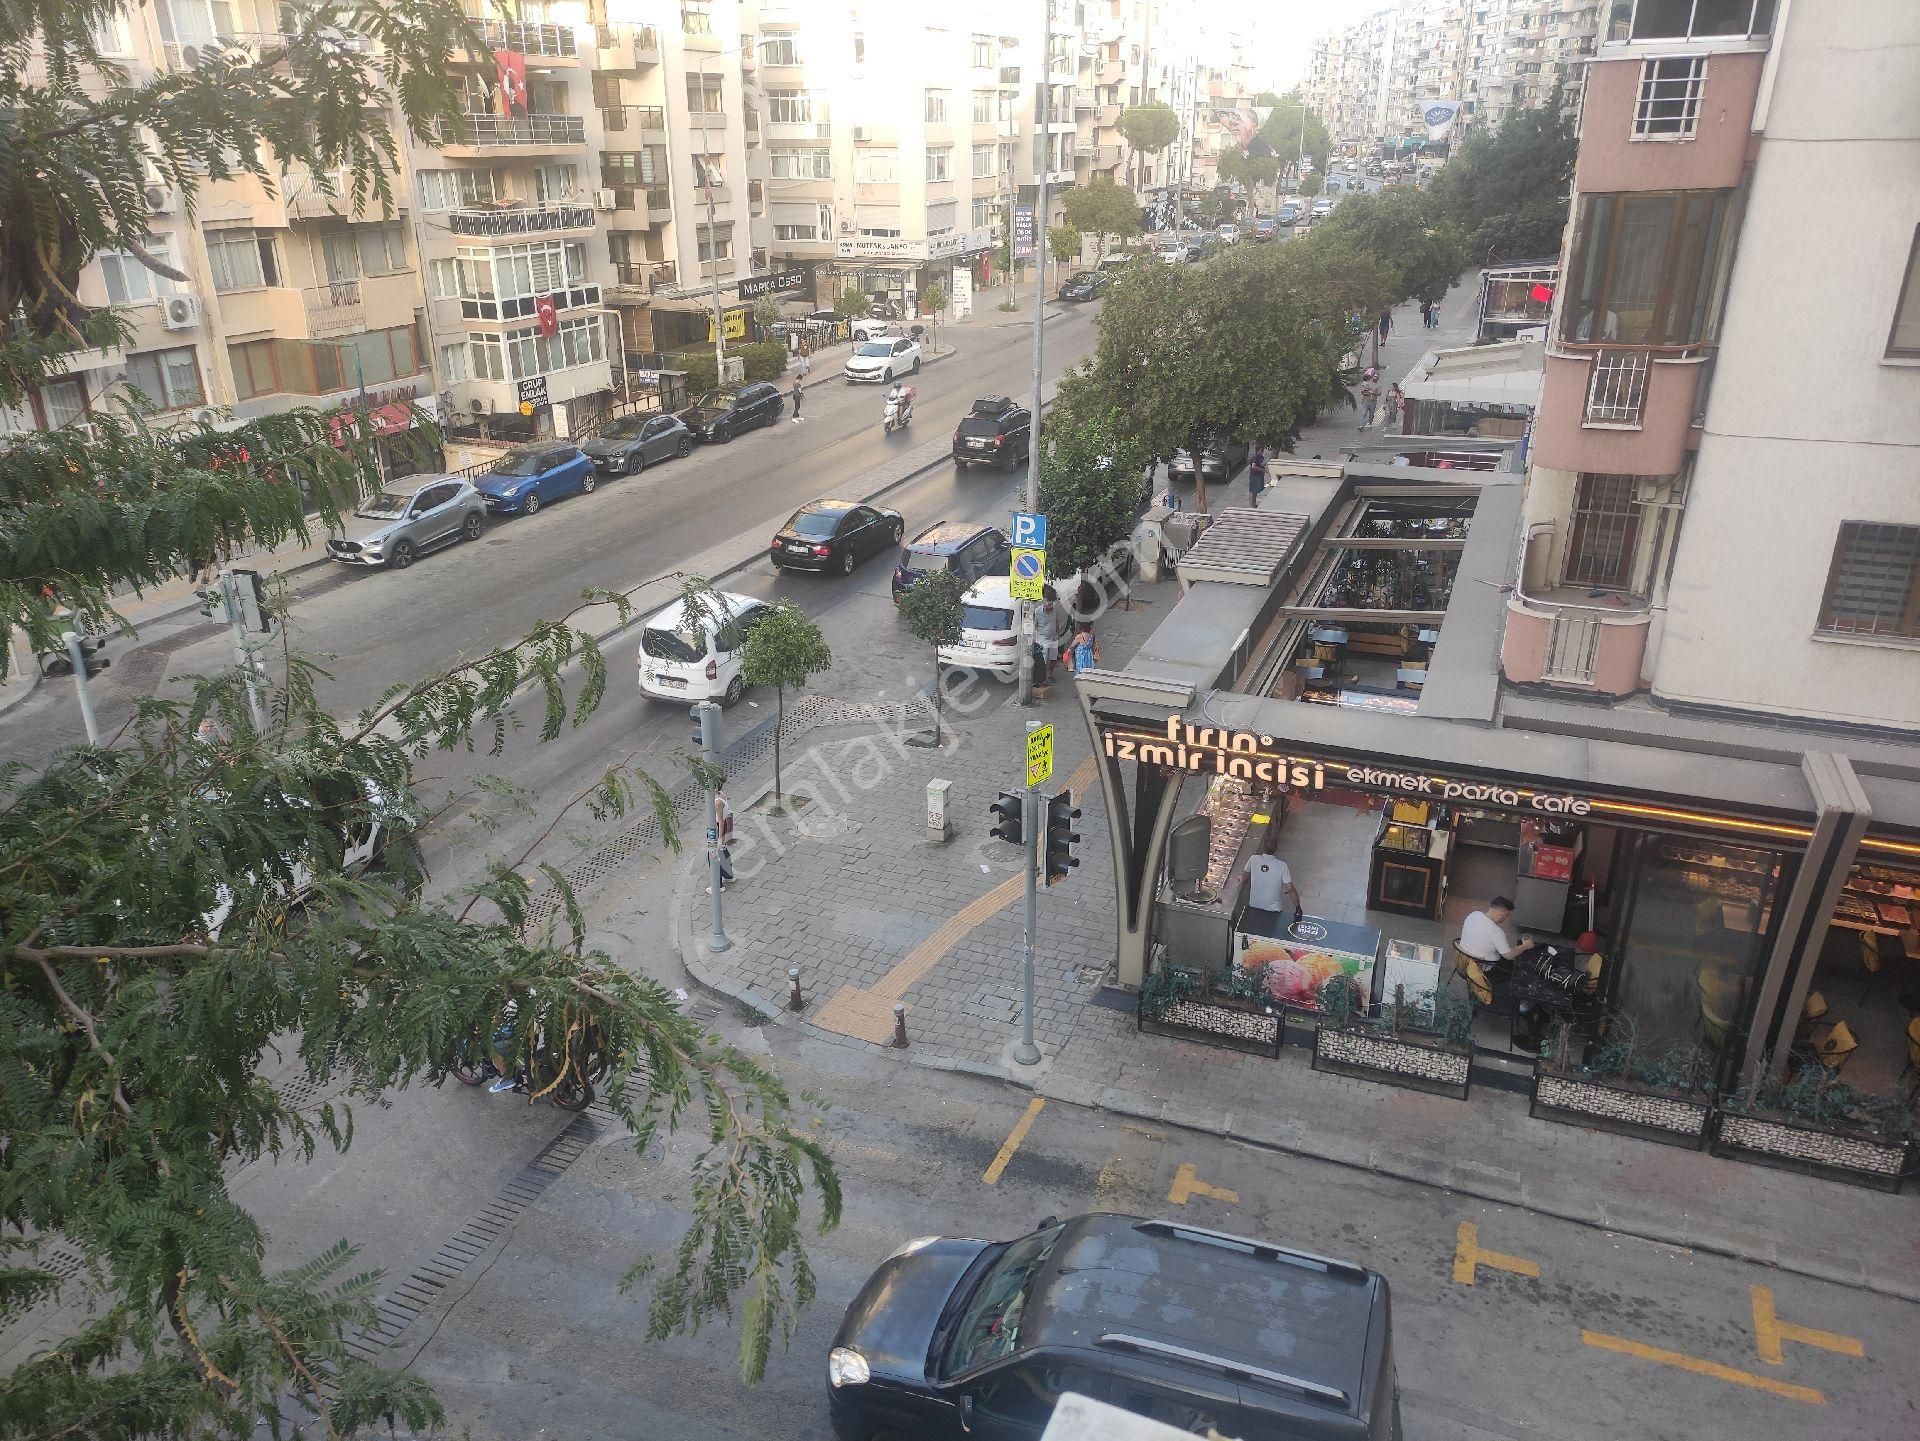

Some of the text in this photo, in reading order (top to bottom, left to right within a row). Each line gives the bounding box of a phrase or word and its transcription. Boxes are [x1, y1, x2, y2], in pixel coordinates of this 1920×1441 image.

[744, 280, 776, 296] MARKA
[520, 386, 547, 401] EMLAK
[522, 378, 543, 391] GRUP
[1015, 515, 1036, 544] P
[1105, 732, 1325, 790] izmir incisi
[1346, 766, 1592, 817] ekmek pasta cafe
